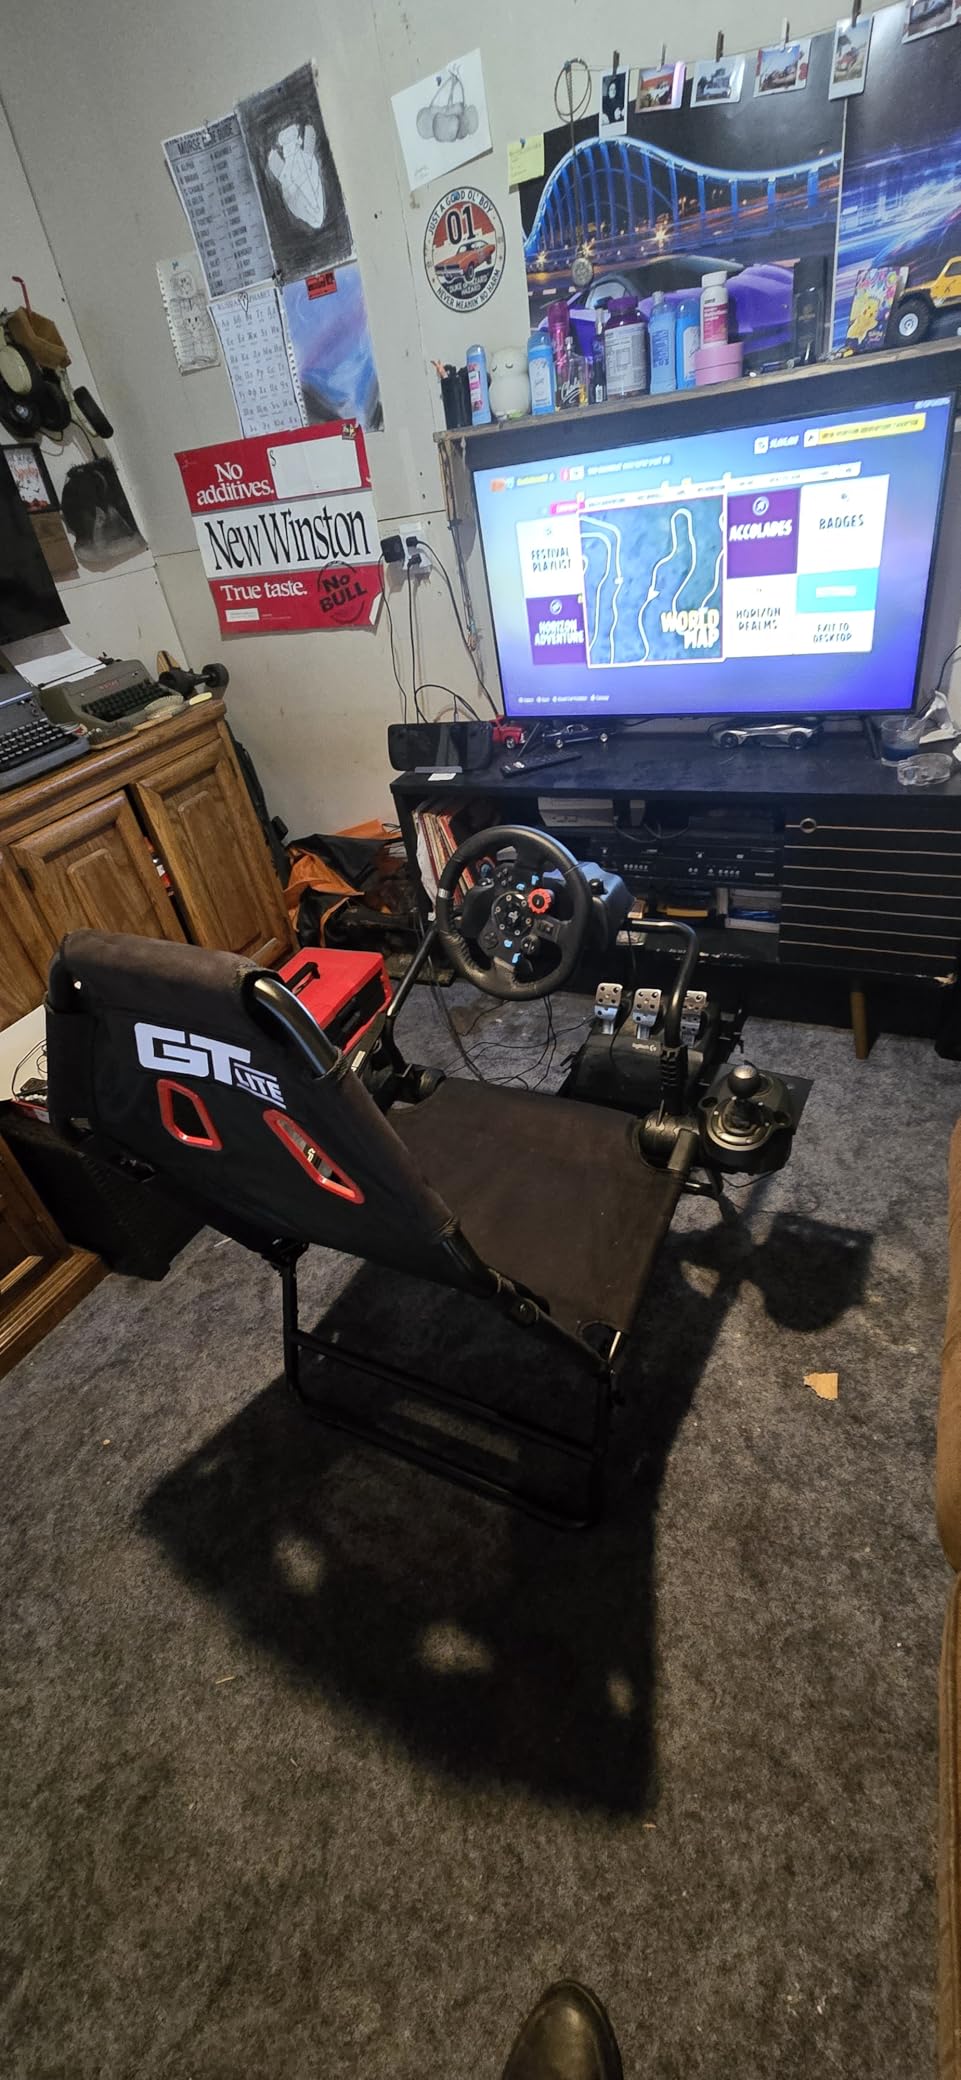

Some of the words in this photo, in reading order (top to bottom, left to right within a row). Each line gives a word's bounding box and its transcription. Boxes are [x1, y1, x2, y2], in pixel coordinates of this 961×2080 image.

[428, 210, 440, 235] JUST
[440, 203, 446, 213] A
[478, 197, 493, 214] BOY
[446, 204, 476, 246] 01
[436, 287, 454, 307] NEVER
[479, 291, 489, 304] NO
[487, 269, 501, 294] HARM
[213, 461, 244, 483] No
[196, 478, 275, 506] additives.
[728, 519, 793, 542] ACCOLADES
[819, 514, 864, 530] BADGES
[204, 519, 262, 571] New
[258, 505, 372, 565] Winston
[531, 546, 570, 561] FESTIVAL
[532, 559, 572, 573] PLAYLIST
[220, 584, 262, 602] True
[263, 580, 308, 599] taste.
[322, 574, 350, 593] No
[319, 582, 368, 614] BULL
[660, 607, 720, 635] WORLD
[735, 607, 781, 620] HORIZON
[538, 619, 578, 635] HORIZON
[738, 619, 779, 631] REALMS
[817, 623, 836, 633] EXIT
[839, 622, 850, 632] TO
[534, 630, 585, 647] ADVENTURE
[683, 628, 720, 650] MAP
[812, 632, 853, 644] DESKTOP
[134, 1022, 252, 1086] GT
[234, 1067, 286, 1103] LITE
